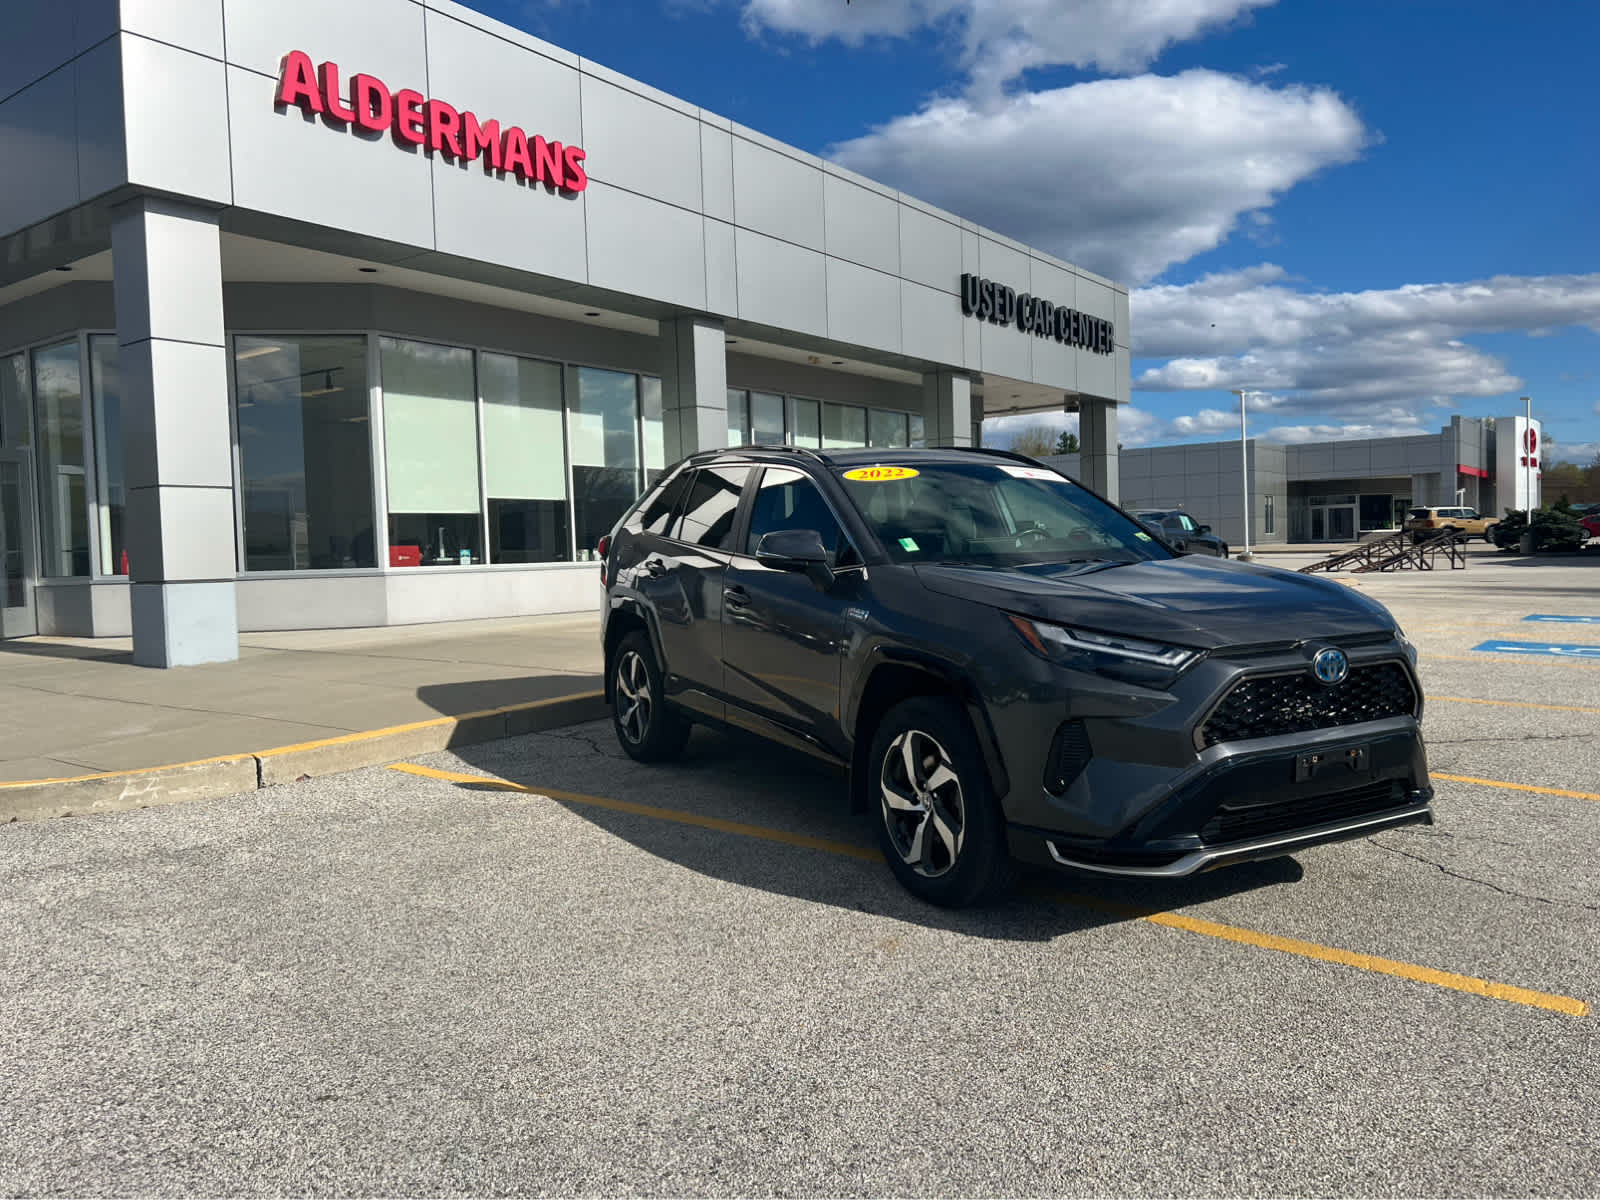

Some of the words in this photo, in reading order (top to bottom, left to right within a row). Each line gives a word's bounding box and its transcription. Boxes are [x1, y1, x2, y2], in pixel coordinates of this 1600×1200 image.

[276, 50, 587, 193] ALDERMANS
[962, 273, 1017, 325] USED
[1017, 292, 1054, 337] CAR
[1055, 305, 1114, 353] CENTER
[858, 468, 904, 479] 2022
